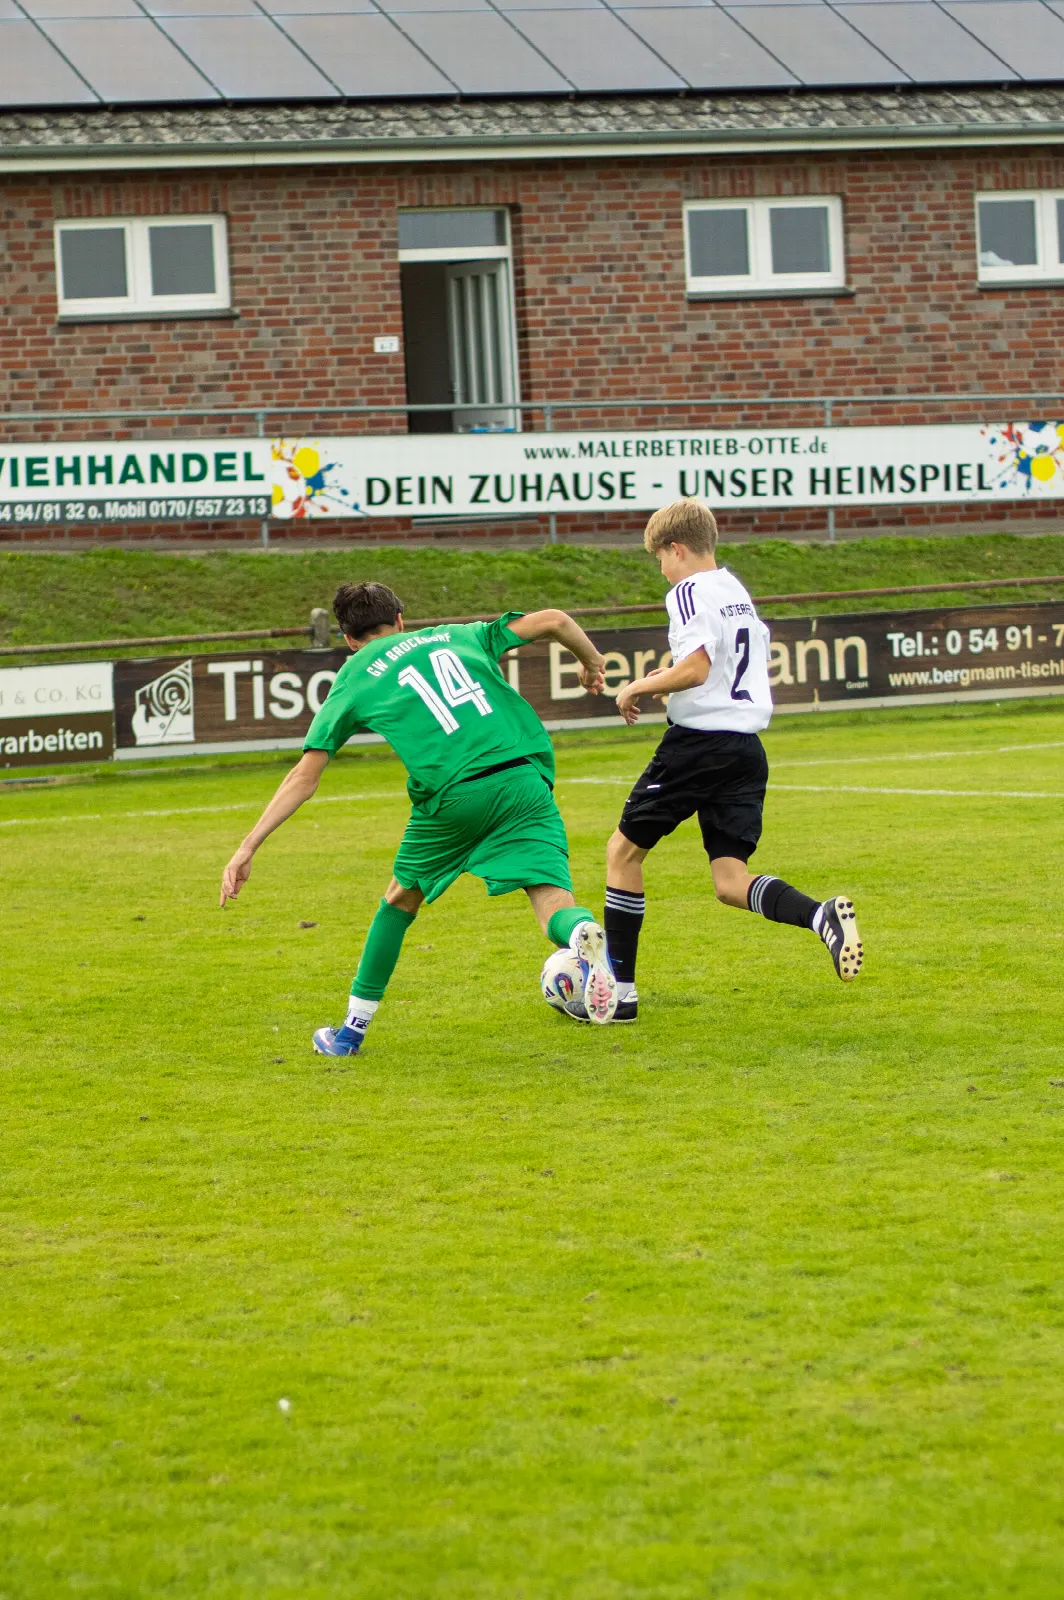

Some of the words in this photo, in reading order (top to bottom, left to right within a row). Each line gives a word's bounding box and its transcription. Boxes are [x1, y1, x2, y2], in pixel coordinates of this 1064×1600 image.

[0, 451, 265, 487] IEHHANDEL
[366, 475, 453, 506] DEIN
[470, 471, 637, 503] ZUHAUSE
[679, 467, 794, 497] UNSER
[809, 463, 993, 496] HEIMSPIEL
[0, 503, 11, 521] 4
[65, 502, 85, 520] 32
[105, 500, 146, 520] Mobil
[149, 499, 223, 517] 0170/557
[225, 498, 245, 516] 23
[248, 498, 267, 515] 13
[887, 631, 938, 658] Tel.:
[946, 630, 962, 655] 0
[969, 627, 999, 653] 54
[366, 658, 388, 677] GW
[730, 628, 754, 703] 2
[15, 690, 25, 704] &
[76, 684, 102, 701] KG
[398, 649, 493, 735] 14
